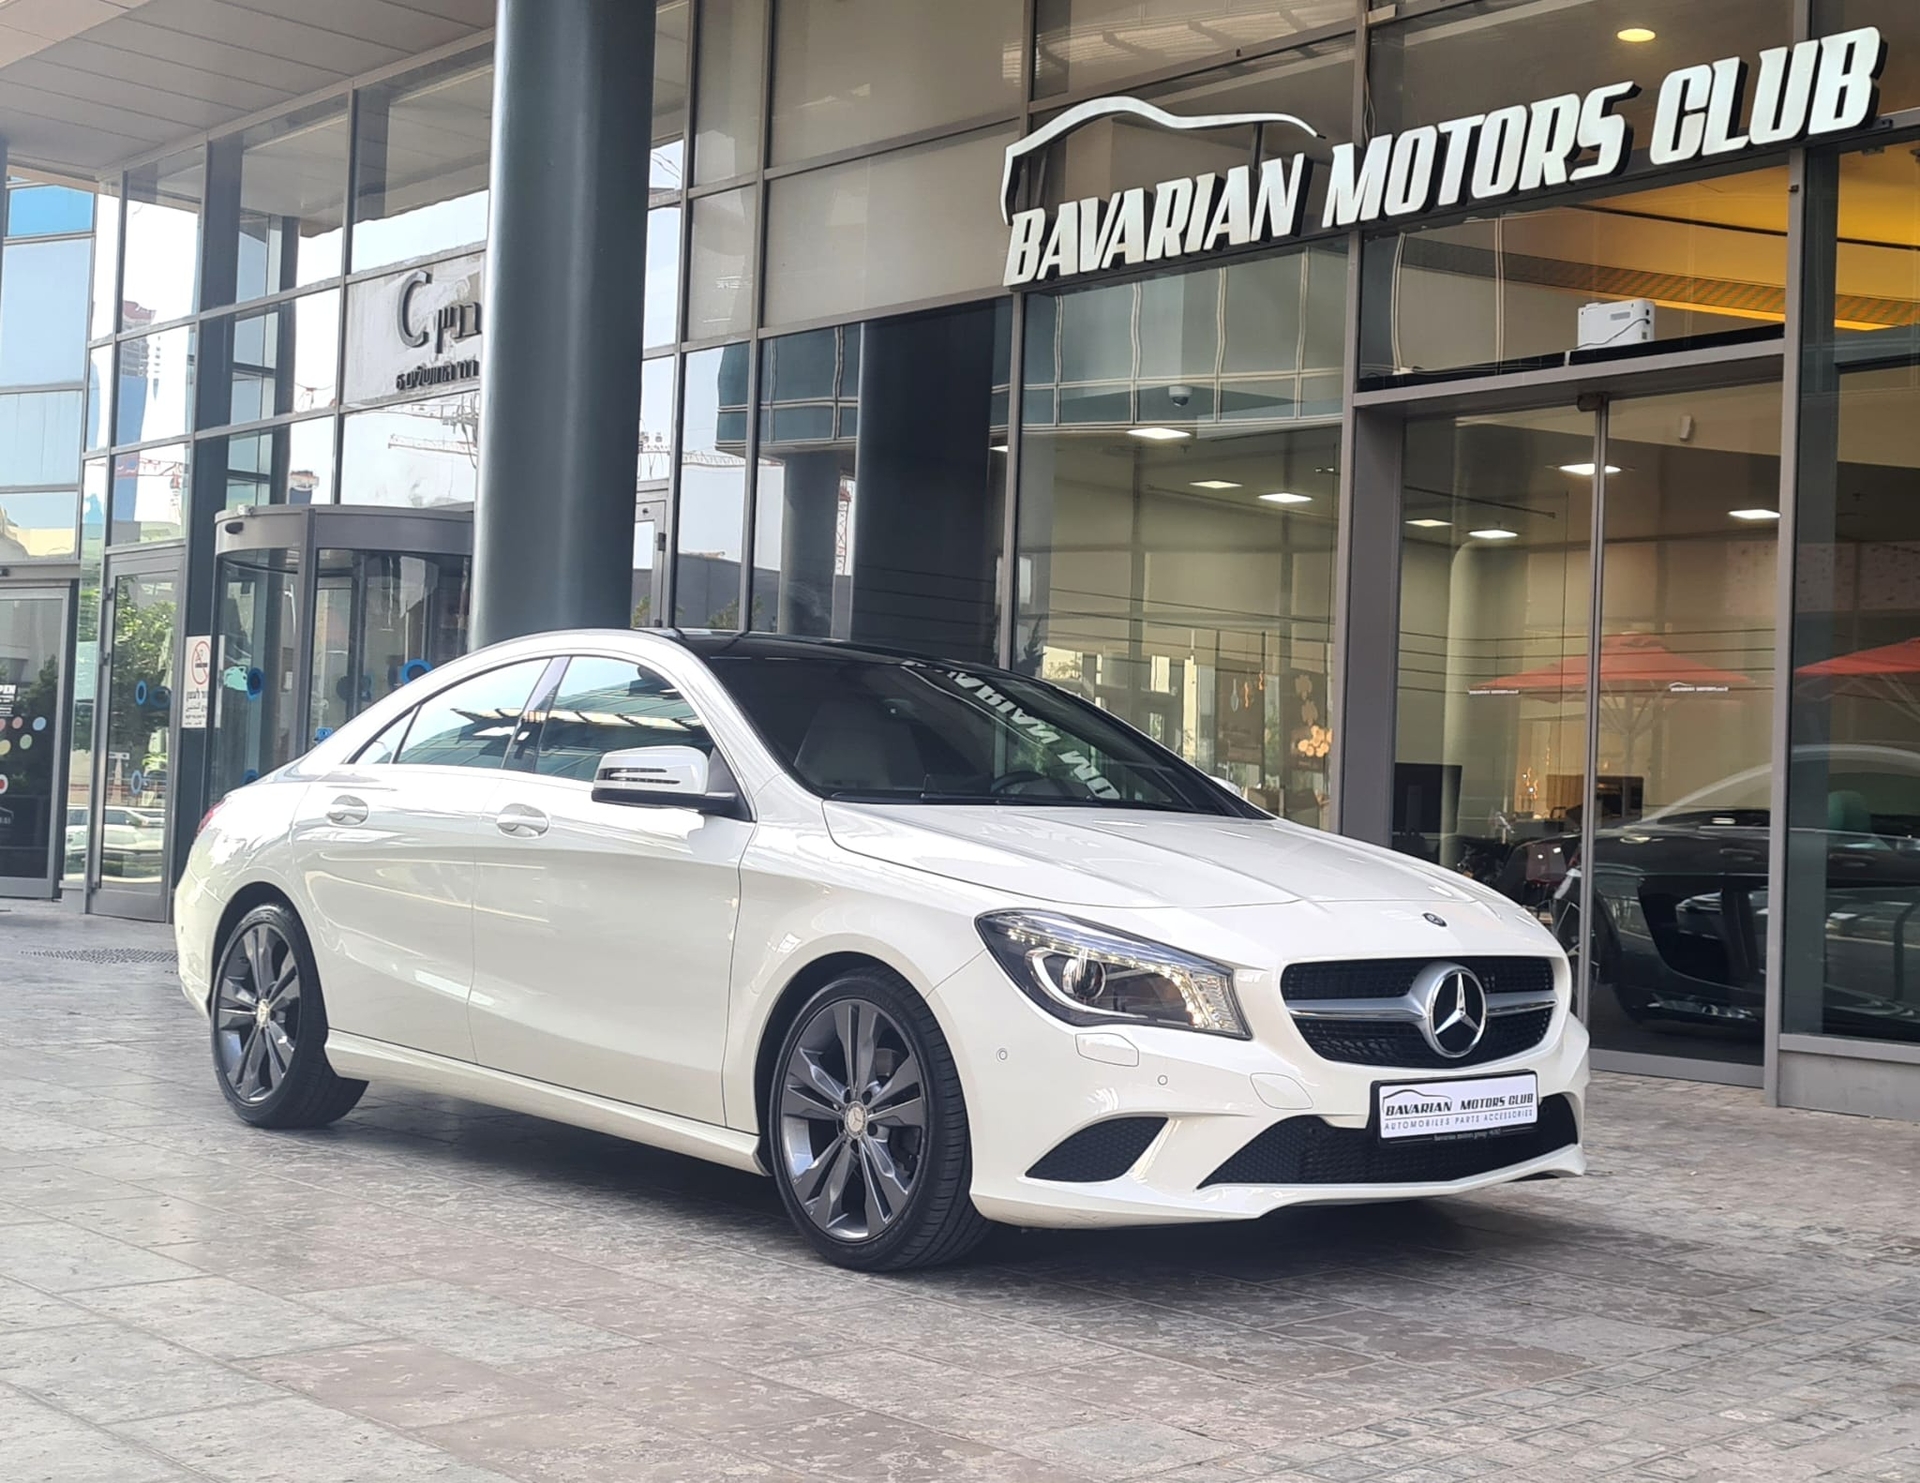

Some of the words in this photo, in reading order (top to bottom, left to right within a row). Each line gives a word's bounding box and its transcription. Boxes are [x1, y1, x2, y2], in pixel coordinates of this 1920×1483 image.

[1004, 154, 1305, 287] BAVARIAN
[1321, 81, 1640, 229] MOTORS
[1650, 27, 1885, 167] CLUB
[397, 270, 433, 348] C
[1384, 1118, 1450, 1131] AUTOMOBILES
[1454, 1115, 1480, 1125] PARTS
[1483, 1109, 1534, 1122] ACCESSORIES
[1386, 1102, 1452, 1116] BAVARIAN
[1460, 1096, 1505, 1110] MOTORS
[1508, 1093, 1534, 1106] CLUB
